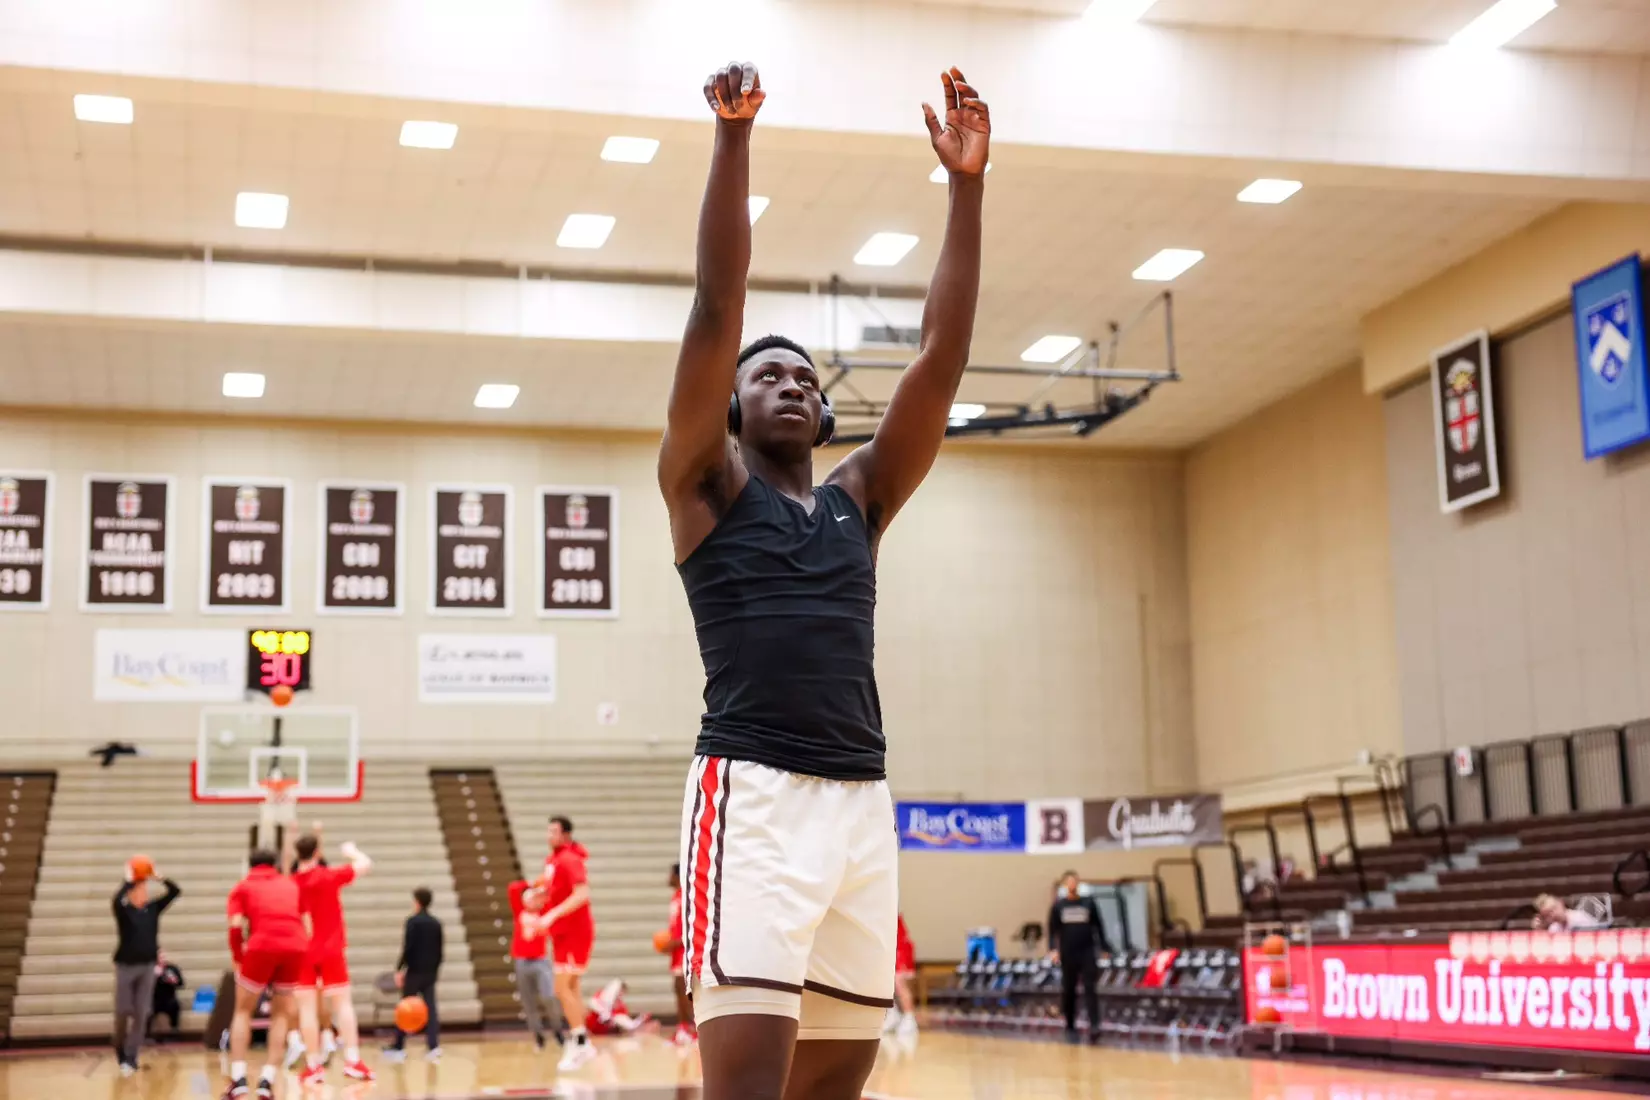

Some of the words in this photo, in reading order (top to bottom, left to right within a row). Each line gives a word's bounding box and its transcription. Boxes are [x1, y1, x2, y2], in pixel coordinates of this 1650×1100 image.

[260, 652, 301, 686] 30
[1039, 809, 1069, 845] B
[1322, 957, 1430, 1022] Brown
[1434, 957, 1650, 1050] University
